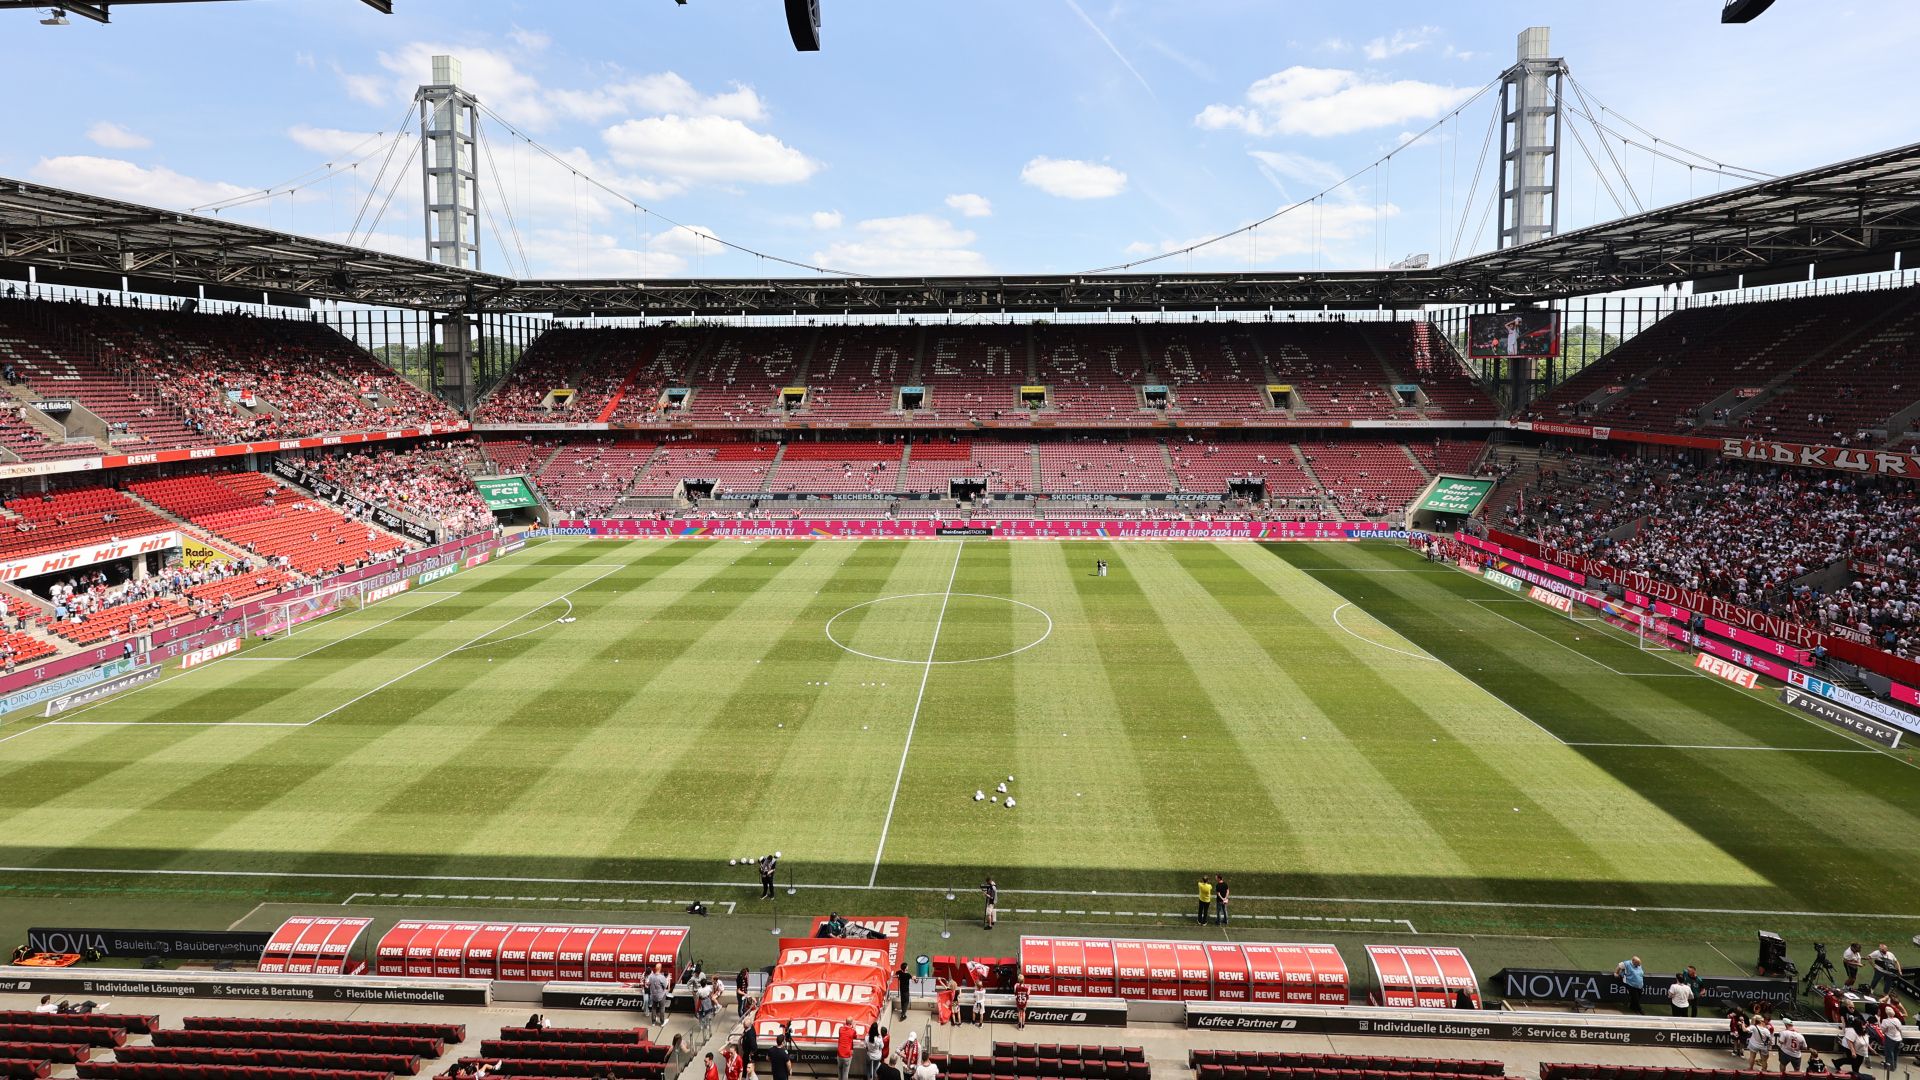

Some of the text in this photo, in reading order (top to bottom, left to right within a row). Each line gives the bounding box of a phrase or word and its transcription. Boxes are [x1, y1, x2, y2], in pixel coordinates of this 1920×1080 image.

[280, 440, 300, 449] REWE
[323, 436, 342, 444] REWE
[190, 448, 216, 458] REWE
[128, 454, 157, 465] REWE
[491, 487, 519, 496] FC!
[1428, 500, 1470, 509] DEVK
[140, 537, 171, 551] HIT
[94, 545, 128, 562] HIT
[185, 548, 214, 557] Radio
[42, 554, 80, 573] HIT
[386, 573, 400, 584] DER
[402, 566, 422, 578] EURO
[423, 561, 439, 572] 2024
[440, 554, 455, 567] LIVE
[424, 564, 454, 582] DEVK
[1486, 570, 1514, 588] DEVK
[1512, 567, 1526, 580] NUR
[1527, 572, 1539, 584] BEI
[373, 580, 408, 601] REWE
[1531, 586, 1565, 610] REWE
[1539, 545, 1551, 561] FC
[1554, 549, 1578, 568] JEFF
[1581, 558, 1601, 577] JAS
[1712, 601, 1828, 648] RESIGNIERT
[190, 638, 238, 667] REWE
[1699, 654, 1747, 686] REWE
[11, 670, 102, 705] DINO ARSLANOVIC
[1837, 689, 1862, 704] DINO
[30, 933, 109, 954] NOVIA
[115, 940, 172, 952] Bauleitug,
[268, 942, 293, 951] REWE
[297, 943, 320, 952] REWE
[323, 944, 347, 953] REWE
[380, 948, 403, 956] REWE
[438, 949, 461, 957] REWE
[502, 951, 525, 959] REWE
[560, 952, 583, 960] REWE
[619, 954, 643, 962] REWE
[260, 964, 284, 972] REWE
[288, 964, 312, 973] REWE
[316, 965, 339, 974] REWE
[1025, 964, 1050, 974] REWE
[1088, 967, 1112, 975] REWE
[1152, 969, 1176, 977] REWE
[1219, 971, 1244, 980] REWE
[1286, 973, 1312, 982] REWE
[1382, 974, 1409, 984] REWE
[1414, 976, 1441, 985] REWE
[1446, 976, 1473, 986] REWE
[96, 983, 195, 995] Individuelle Lösungen
[226, 986, 259, 995] Service
[271, 988, 314, 998] Beratung
[347, 990, 444, 1000] Flexible Mietmodelle
[580, 997, 643, 1007] Kaffee Partn
[1388, 997, 1414, 1007] REWE
[990, 1010, 1068, 1021] Kaffe Partner
[1198, 1016, 1278, 1028] Kaffee Partner
[1374, 1022, 1490, 1037] Individuelle Lösungen
[1527, 1028, 1630, 1042] Service & Beratung
[1670, 1033, 1713, 1044] Flexible
[1790, 1039, 1797, 1048] 5
